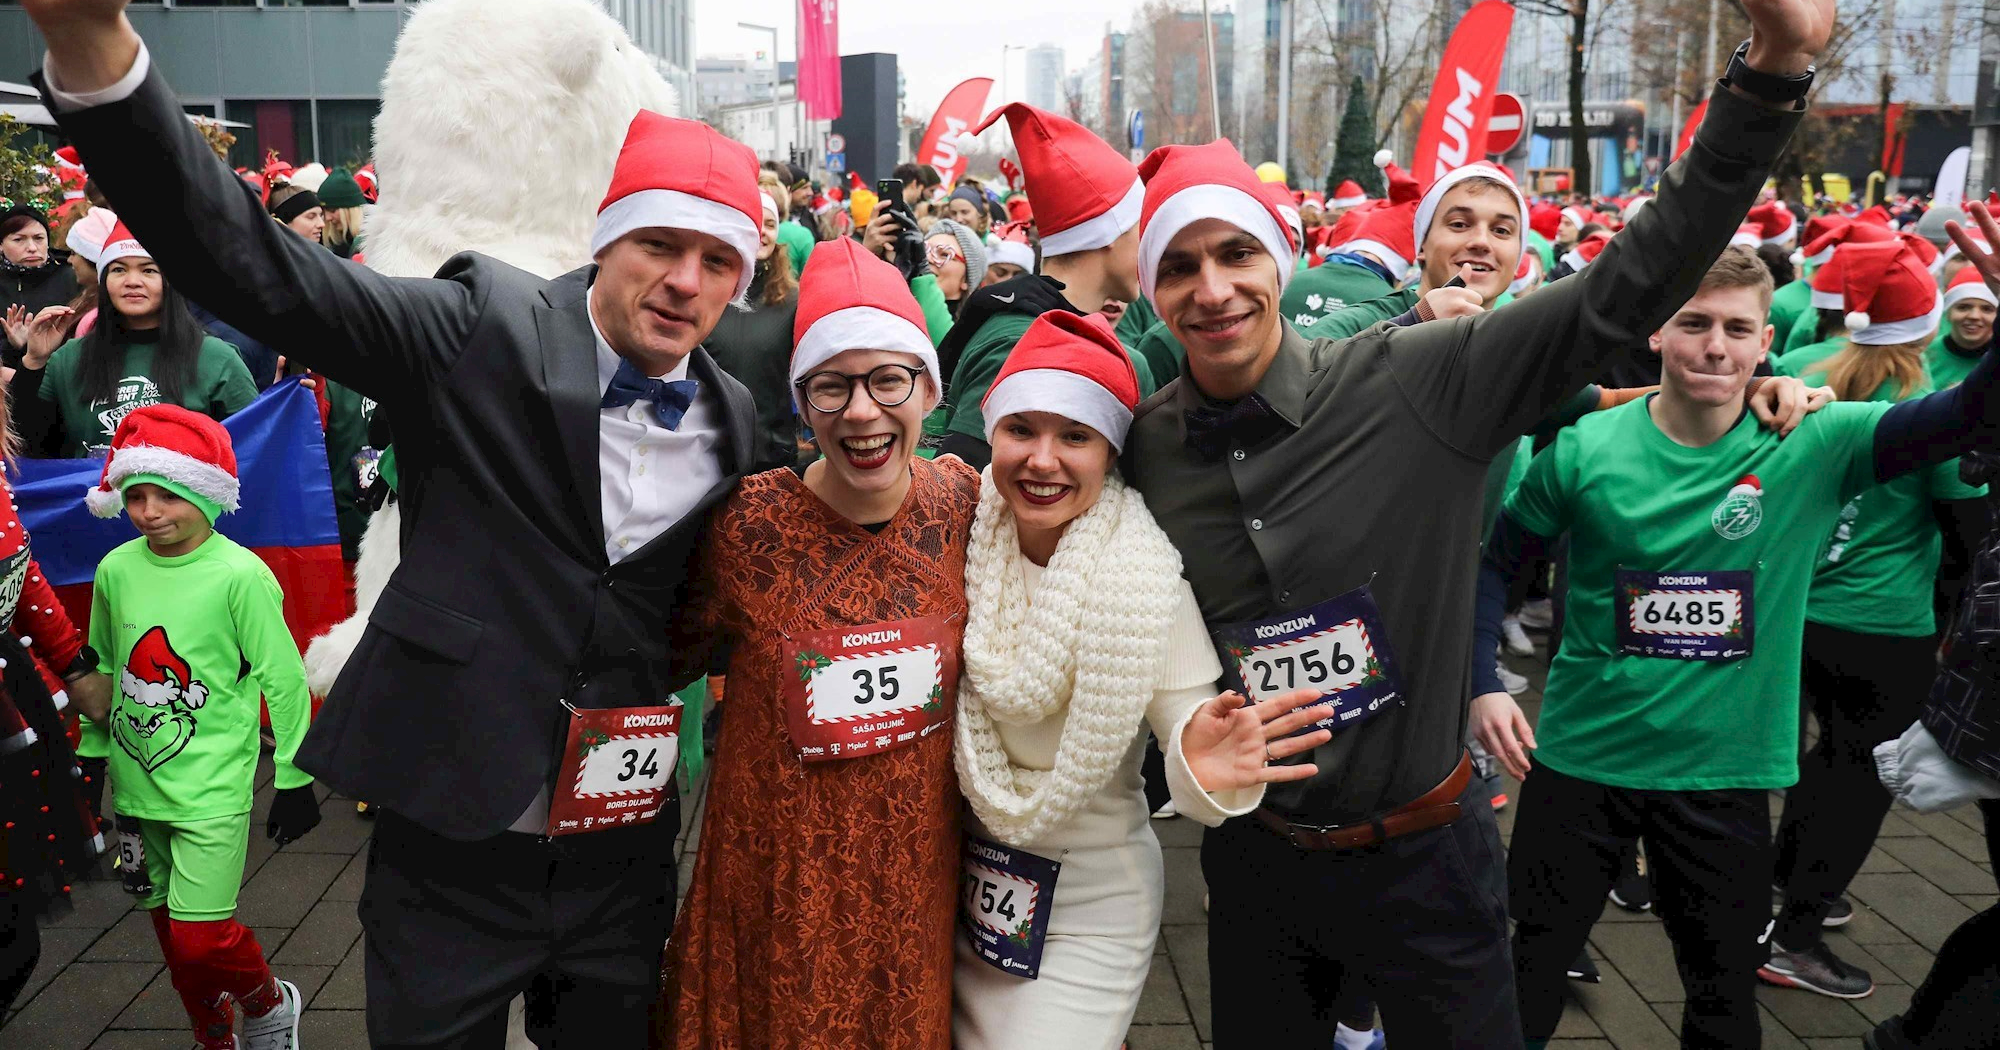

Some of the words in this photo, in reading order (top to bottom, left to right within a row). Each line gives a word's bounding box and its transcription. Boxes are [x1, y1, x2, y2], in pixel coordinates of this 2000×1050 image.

[117, 384, 139, 395] REB
[367, 467, 377, 480] 6
[1658, 575, 1708, 586] KONZUM
[1643, 600, 1725, 625] 6485
[1254, 614, 1316, 639] KONZUM
[842, 629, 901, 648] KONZUM
[1252, 641, 1355, 692] 2756
[852, 665, 900, 704] 35
[623, 714, 675, 728] KONZUM
[852, 722, 875, 735] SAŠA
[876, 716, 905, 731] DUJMIĆ
[617, 748, 658, 782] 34
[605, 799, 628, 810] BORIS
[628, 795, 654, 807] DUJMIĆ
[122, 842, 134, 864] 5
[968, 873, 1016, 922] 754
